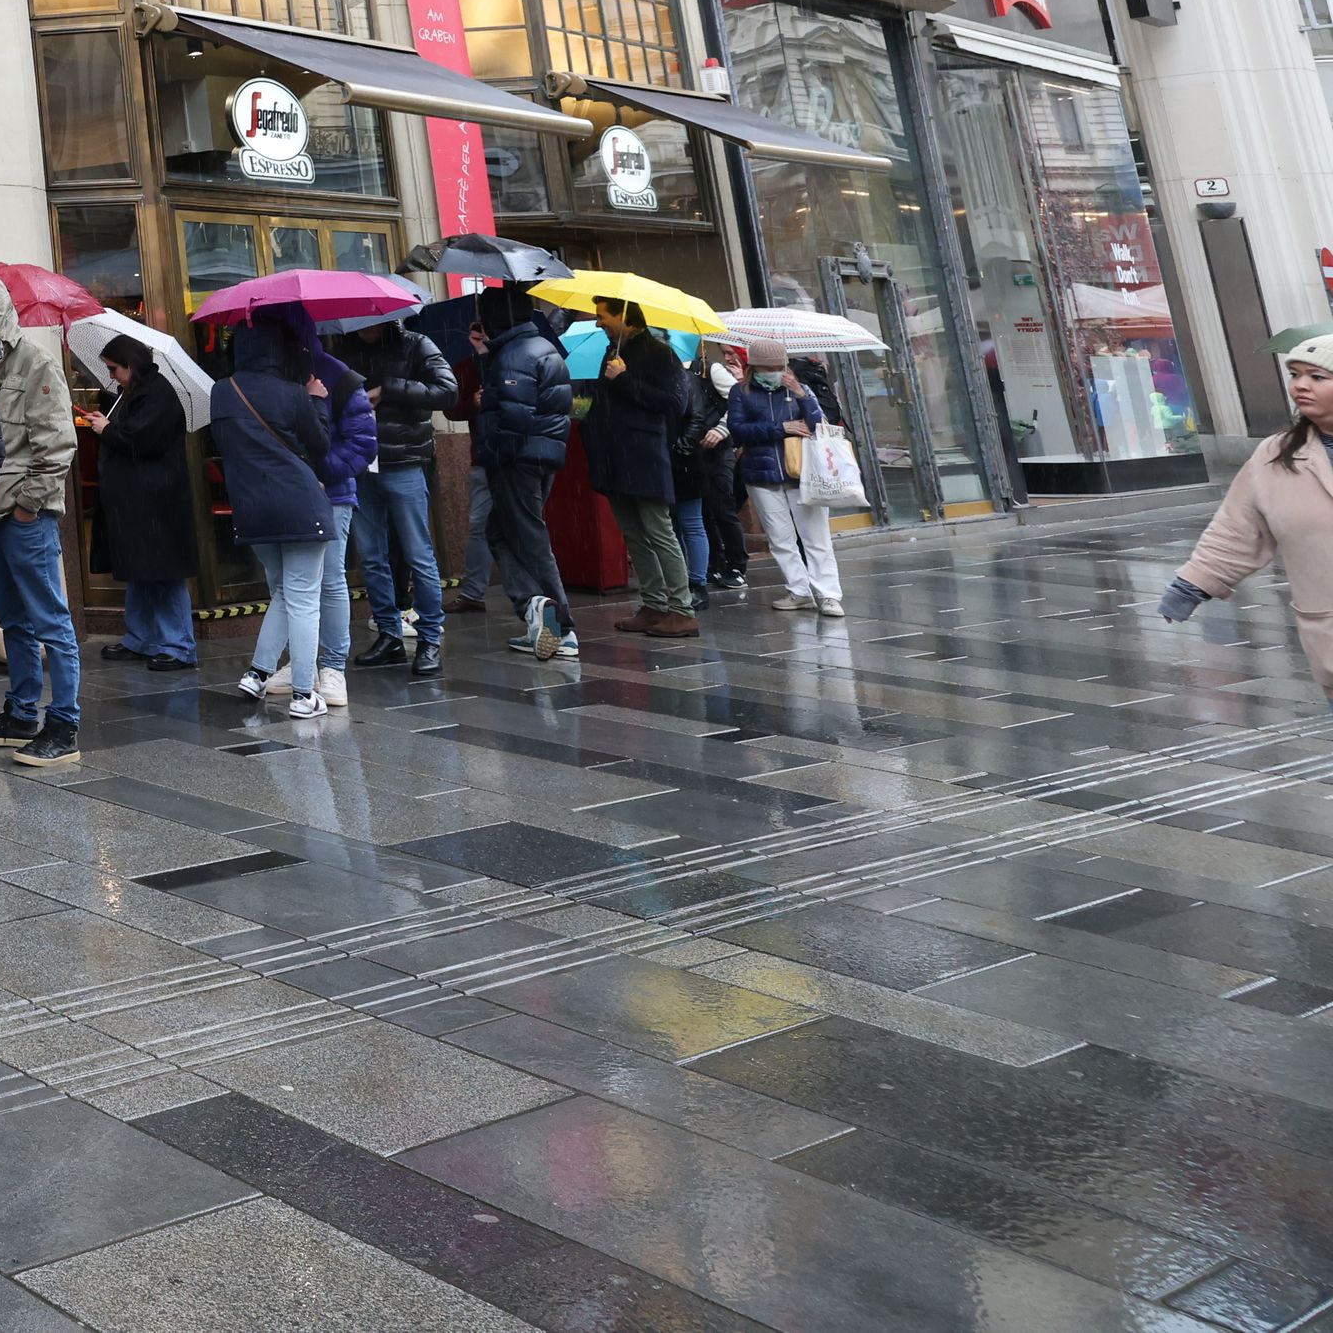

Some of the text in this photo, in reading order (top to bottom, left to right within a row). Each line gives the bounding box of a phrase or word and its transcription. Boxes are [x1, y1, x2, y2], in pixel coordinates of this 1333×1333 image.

[427, 9, 444, 23] AM
[418, 28, 456, 45] GRABEN
[246, 91, 299, 138] Segafredo
[249, 155, 309, 178] ESPRESSO
[461, 140, 470, 176] PER
[1206, 180, 1217, 191] 2
